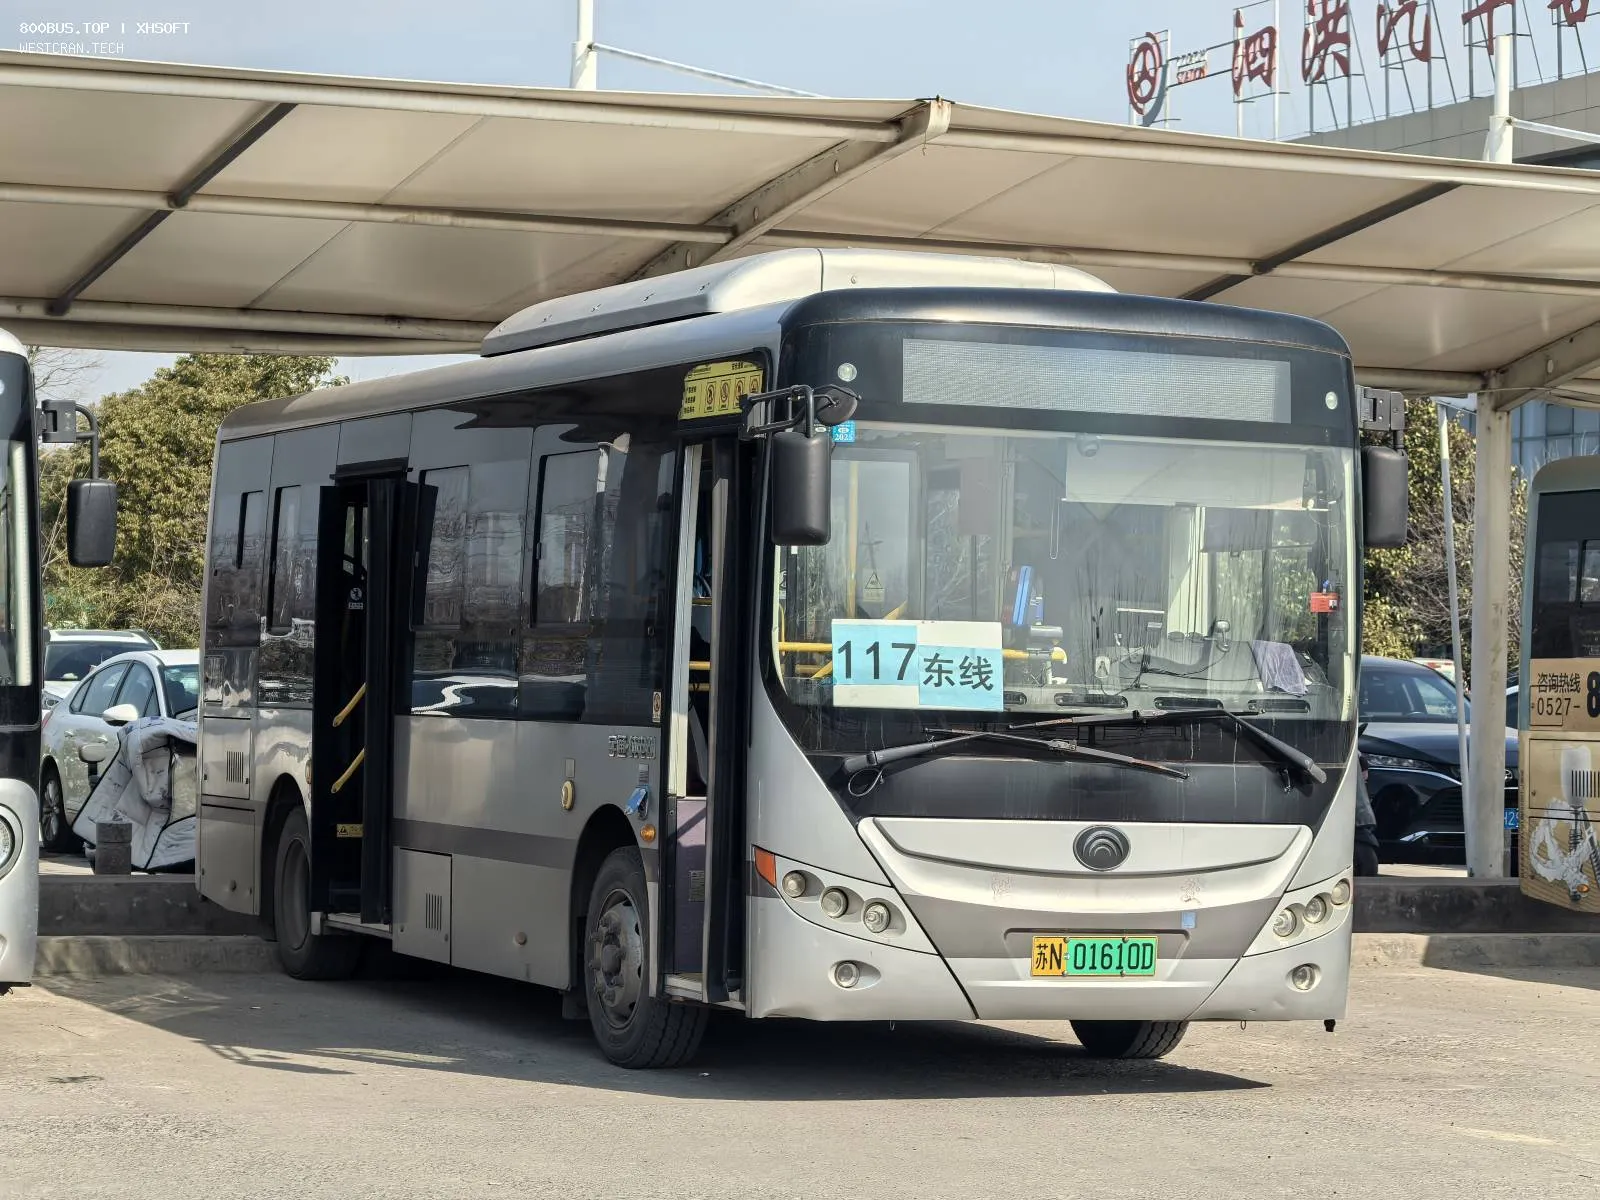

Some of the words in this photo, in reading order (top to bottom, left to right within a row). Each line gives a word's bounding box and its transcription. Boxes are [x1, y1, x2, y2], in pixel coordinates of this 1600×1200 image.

[837, 640, 917, 681] 117
[923, 652, 994, 691] 东线
[1537, 672, 1581, 694] 咨询热线
[1537, 697, 1581, 716] 0527-
